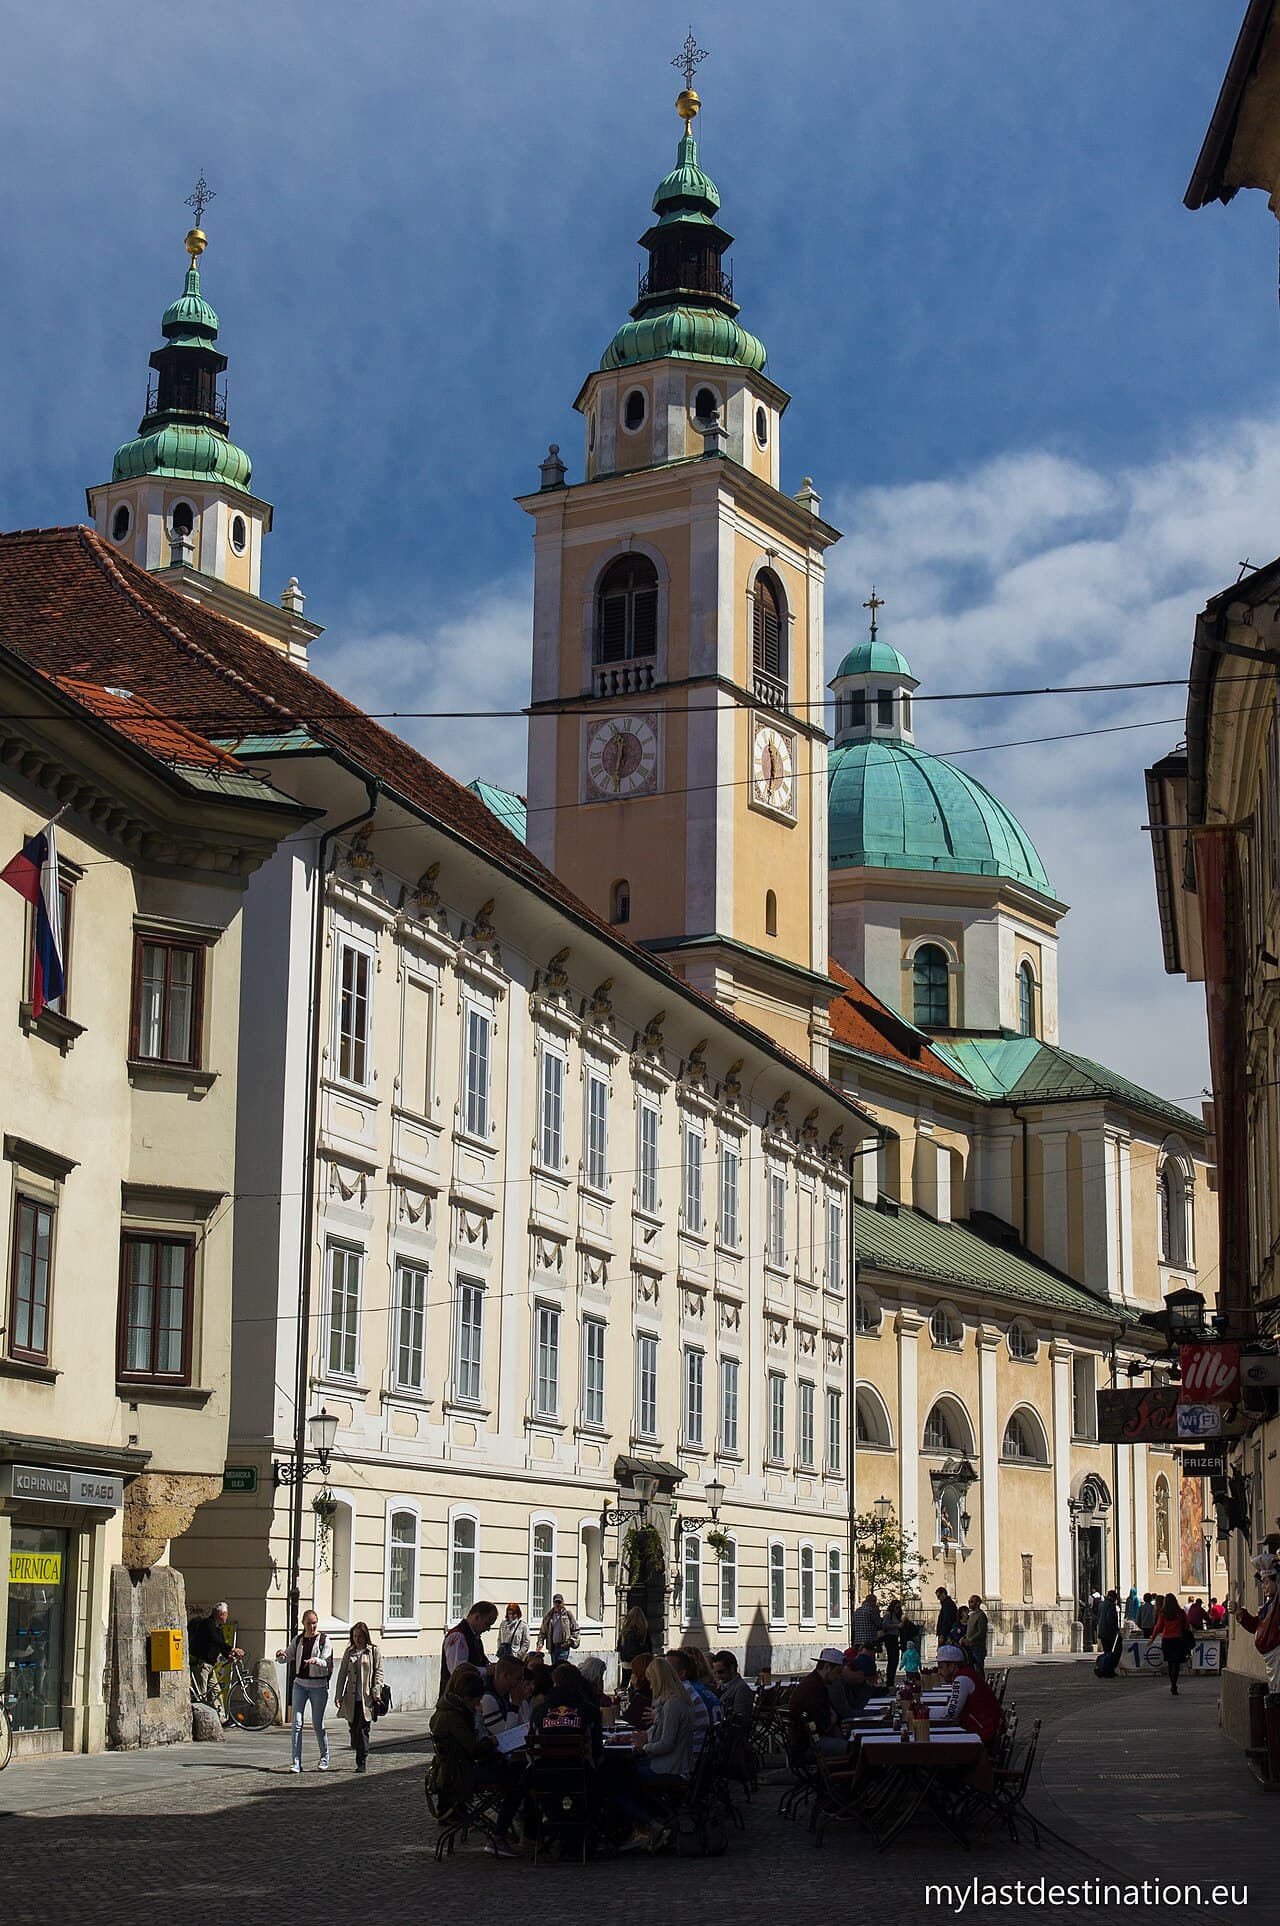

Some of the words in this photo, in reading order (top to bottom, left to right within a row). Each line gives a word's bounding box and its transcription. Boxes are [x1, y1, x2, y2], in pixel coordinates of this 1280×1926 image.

[1184, 1351, 1238, 1397] illy
[1183, 1458, 1221, 1468] FRIZER
[16, 1475, 69, 1494] KOPIRNICA
[81, 1482, 114, 1500] DRAGO
